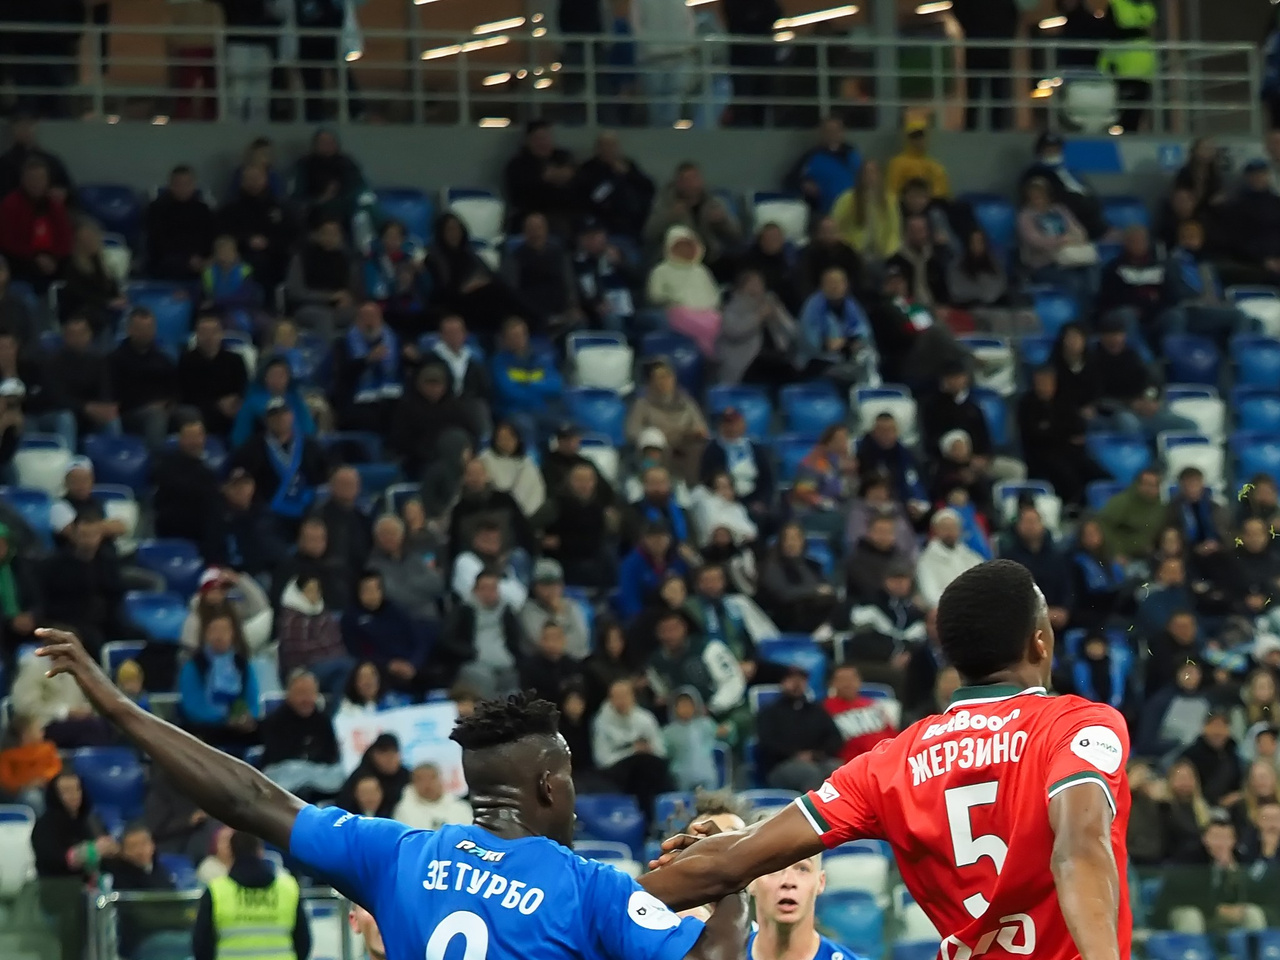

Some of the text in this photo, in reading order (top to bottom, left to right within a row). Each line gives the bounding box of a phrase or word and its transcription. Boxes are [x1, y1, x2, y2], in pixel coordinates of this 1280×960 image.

[908, 730, 1028, 787] ЖЕРЗИНО
[455, 839, 506, 862] PARI
[944, 780, 1008, 919] 5
